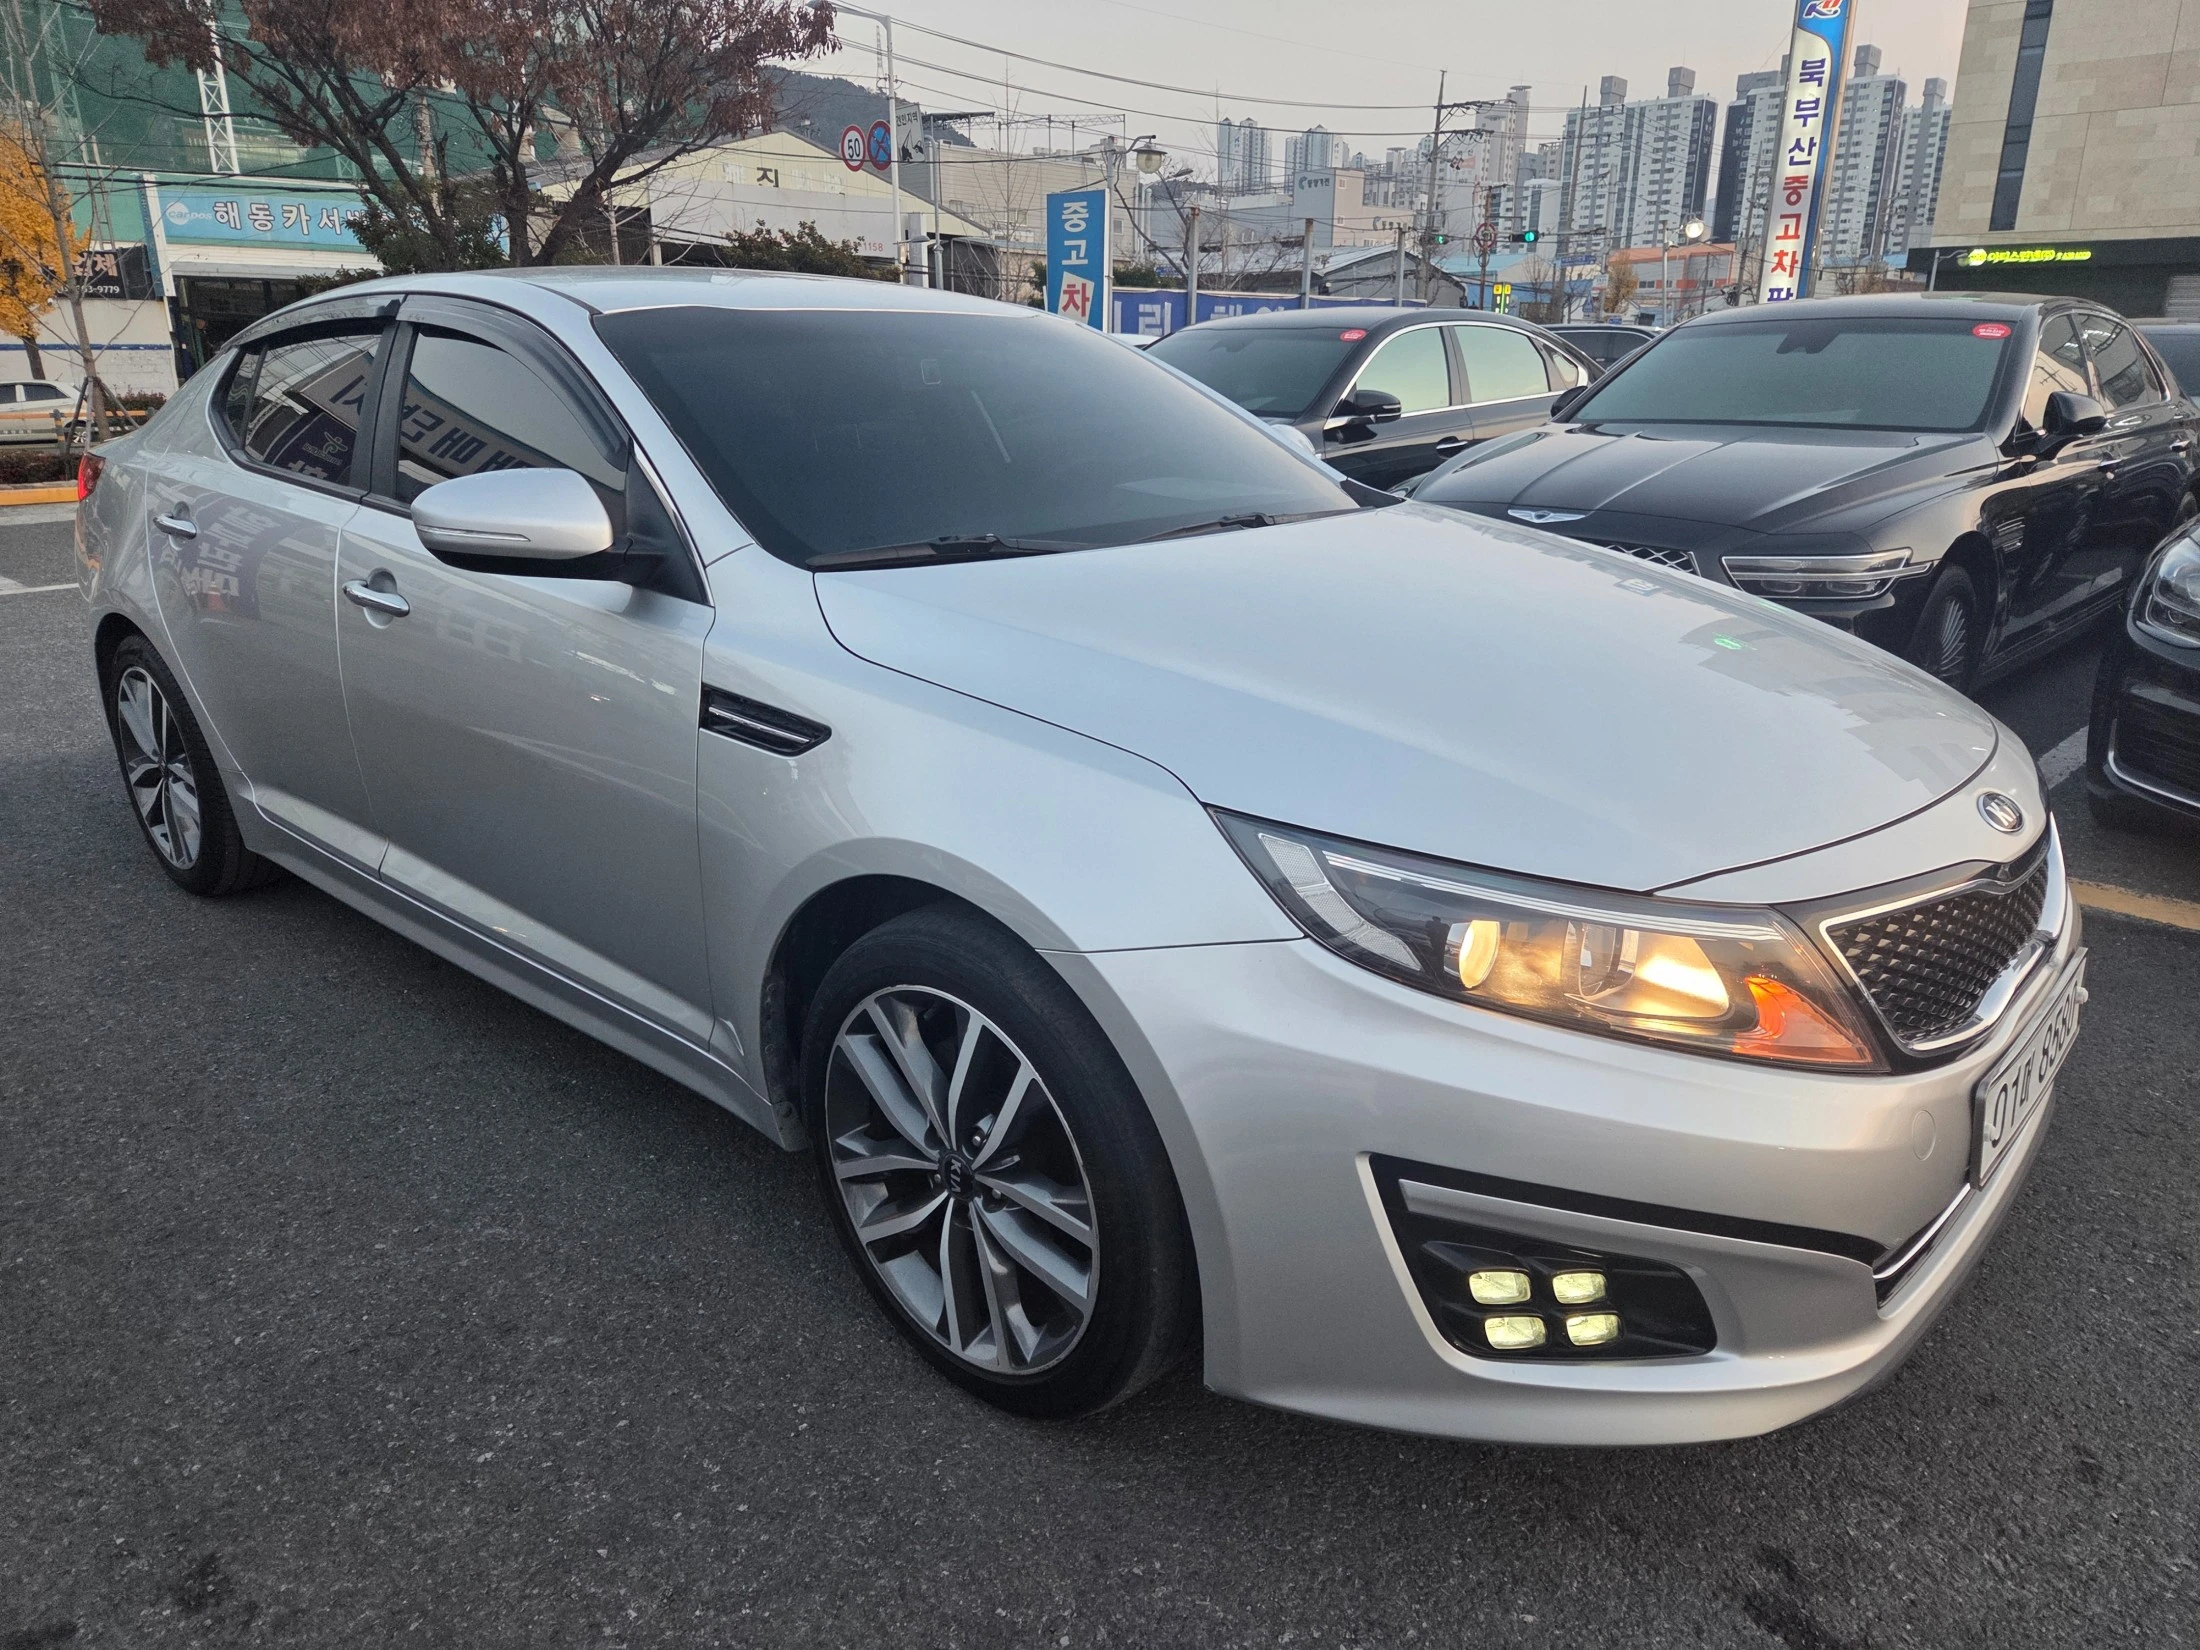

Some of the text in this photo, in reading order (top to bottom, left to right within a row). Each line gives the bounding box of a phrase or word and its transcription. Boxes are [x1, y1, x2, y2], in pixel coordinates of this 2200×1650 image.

[847, 138, 861, 159] 50
[1061, 201, 1090, 318] 중고차
[950, 1159, 962, 1193] KIA
